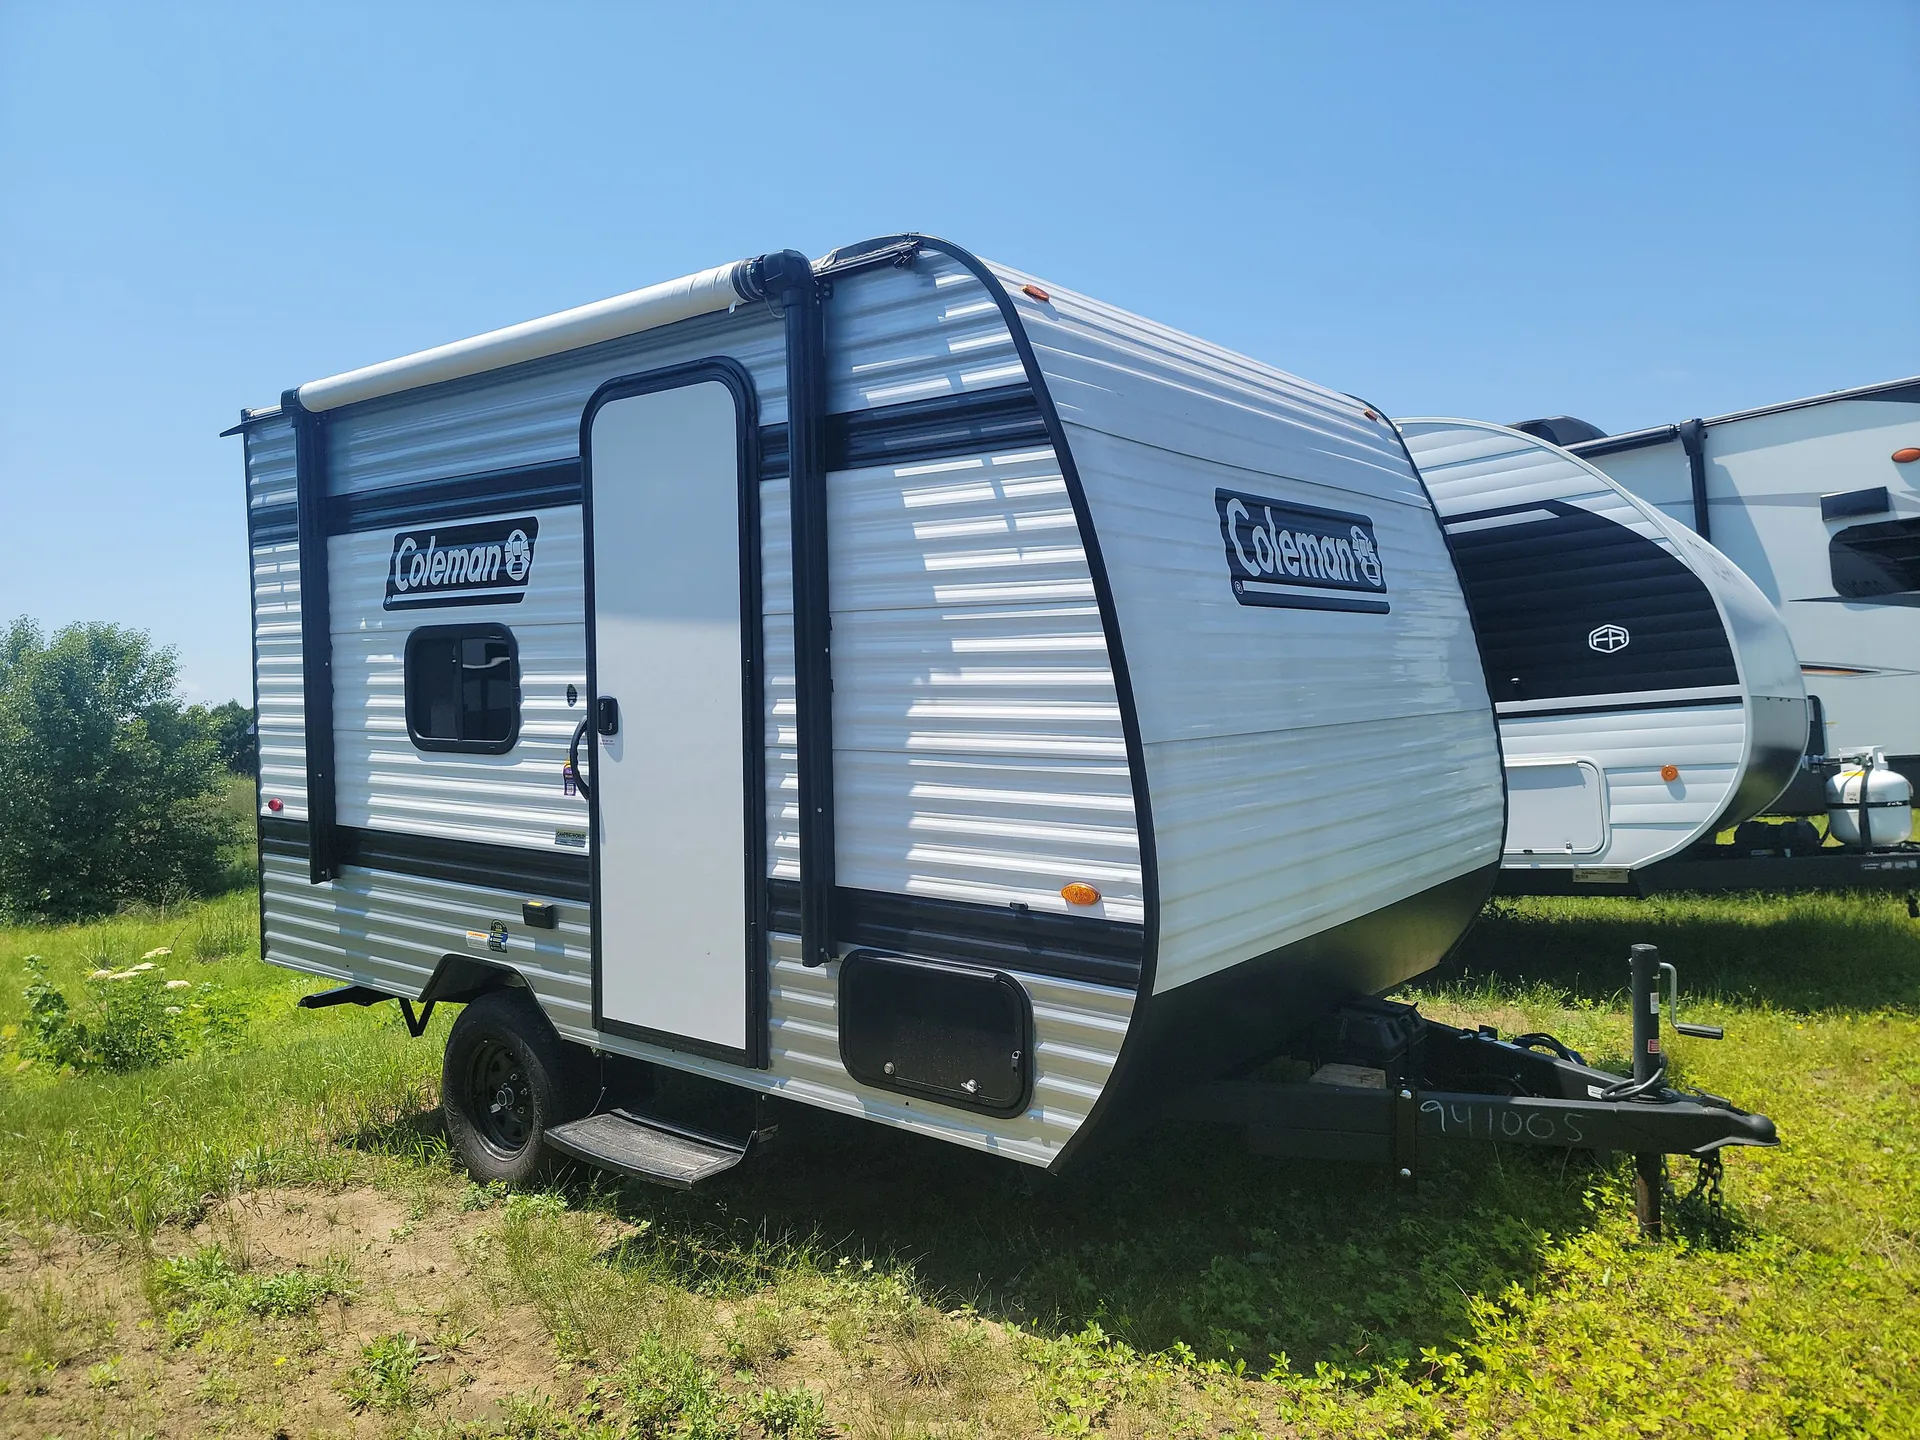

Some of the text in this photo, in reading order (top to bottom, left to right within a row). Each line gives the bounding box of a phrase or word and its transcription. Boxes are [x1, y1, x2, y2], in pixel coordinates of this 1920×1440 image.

[395, 535, 501, 592] Coleman
[1226, 498, 1359, 583] Coleman
[1592, 628, 1625, 650] FR
